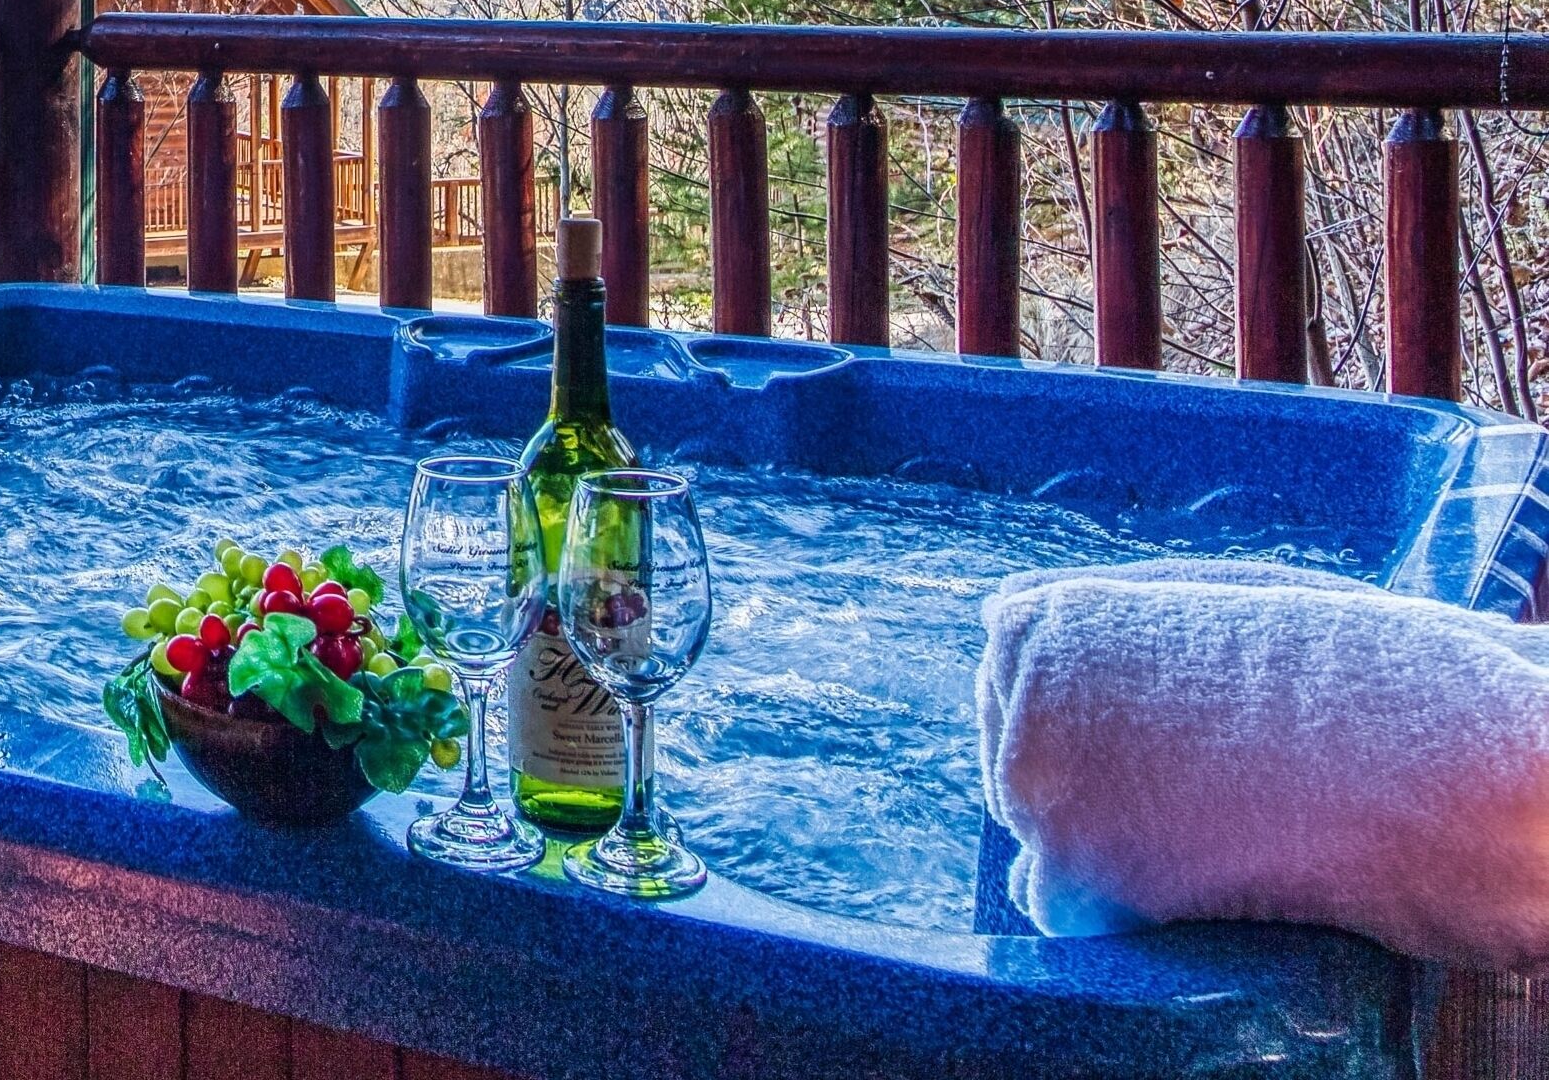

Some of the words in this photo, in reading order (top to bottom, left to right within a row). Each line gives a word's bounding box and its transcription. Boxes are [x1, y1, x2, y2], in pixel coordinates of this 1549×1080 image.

[433, 543, 463, 555] Solid
[467, 544, 511, 559] Ground
[552, 729, 582, 743] Sweet
[584, 733, 625, 744] Marcella
